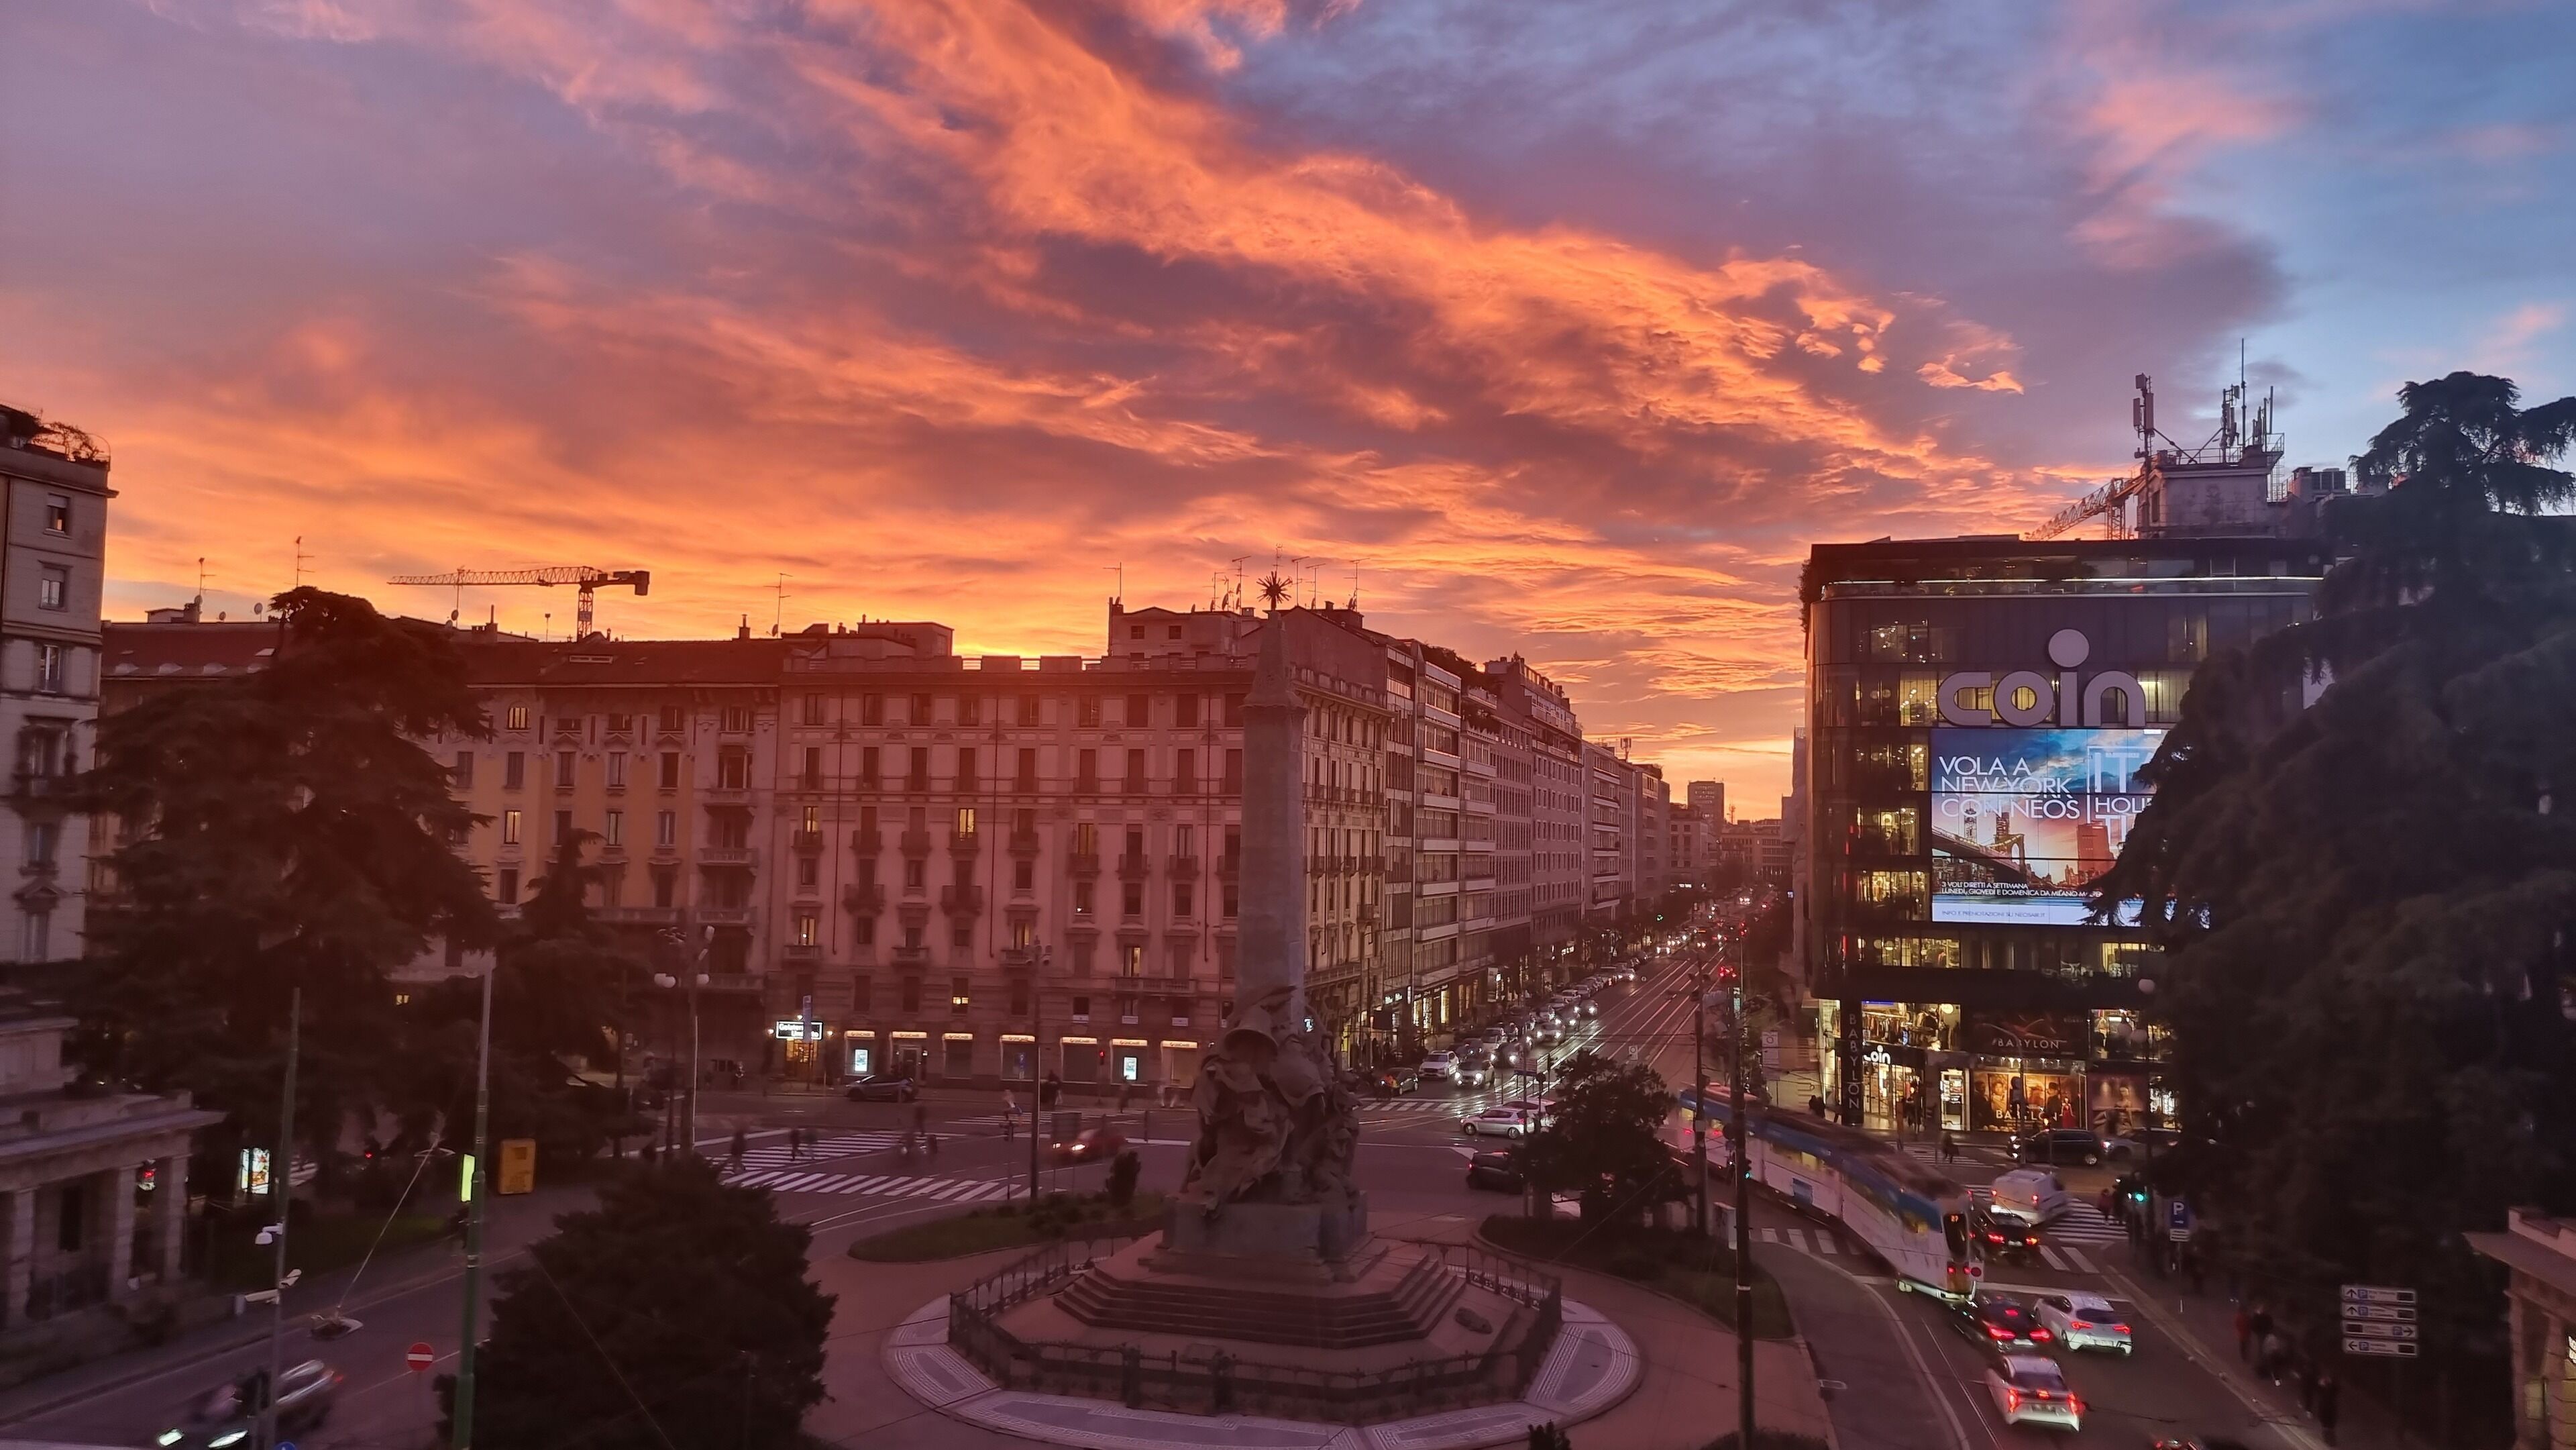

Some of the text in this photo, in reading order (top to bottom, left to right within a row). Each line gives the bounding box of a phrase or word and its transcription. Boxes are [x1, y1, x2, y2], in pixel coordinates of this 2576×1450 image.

[1937, 629, 2146, 727] coin
[1939, 756, 2031, 775] VOLA A
[2094, 752, 2154, 793] IT
[1941, 776, 2074, 799] NEW YORK
[1941, 798, 2080, 819] CON NEOS
[2051, 889, 2078, 897] MILANO
[1848, 1013, 1860, 1109] BABYLON
[2174, 1202, 2185, 1215] P
